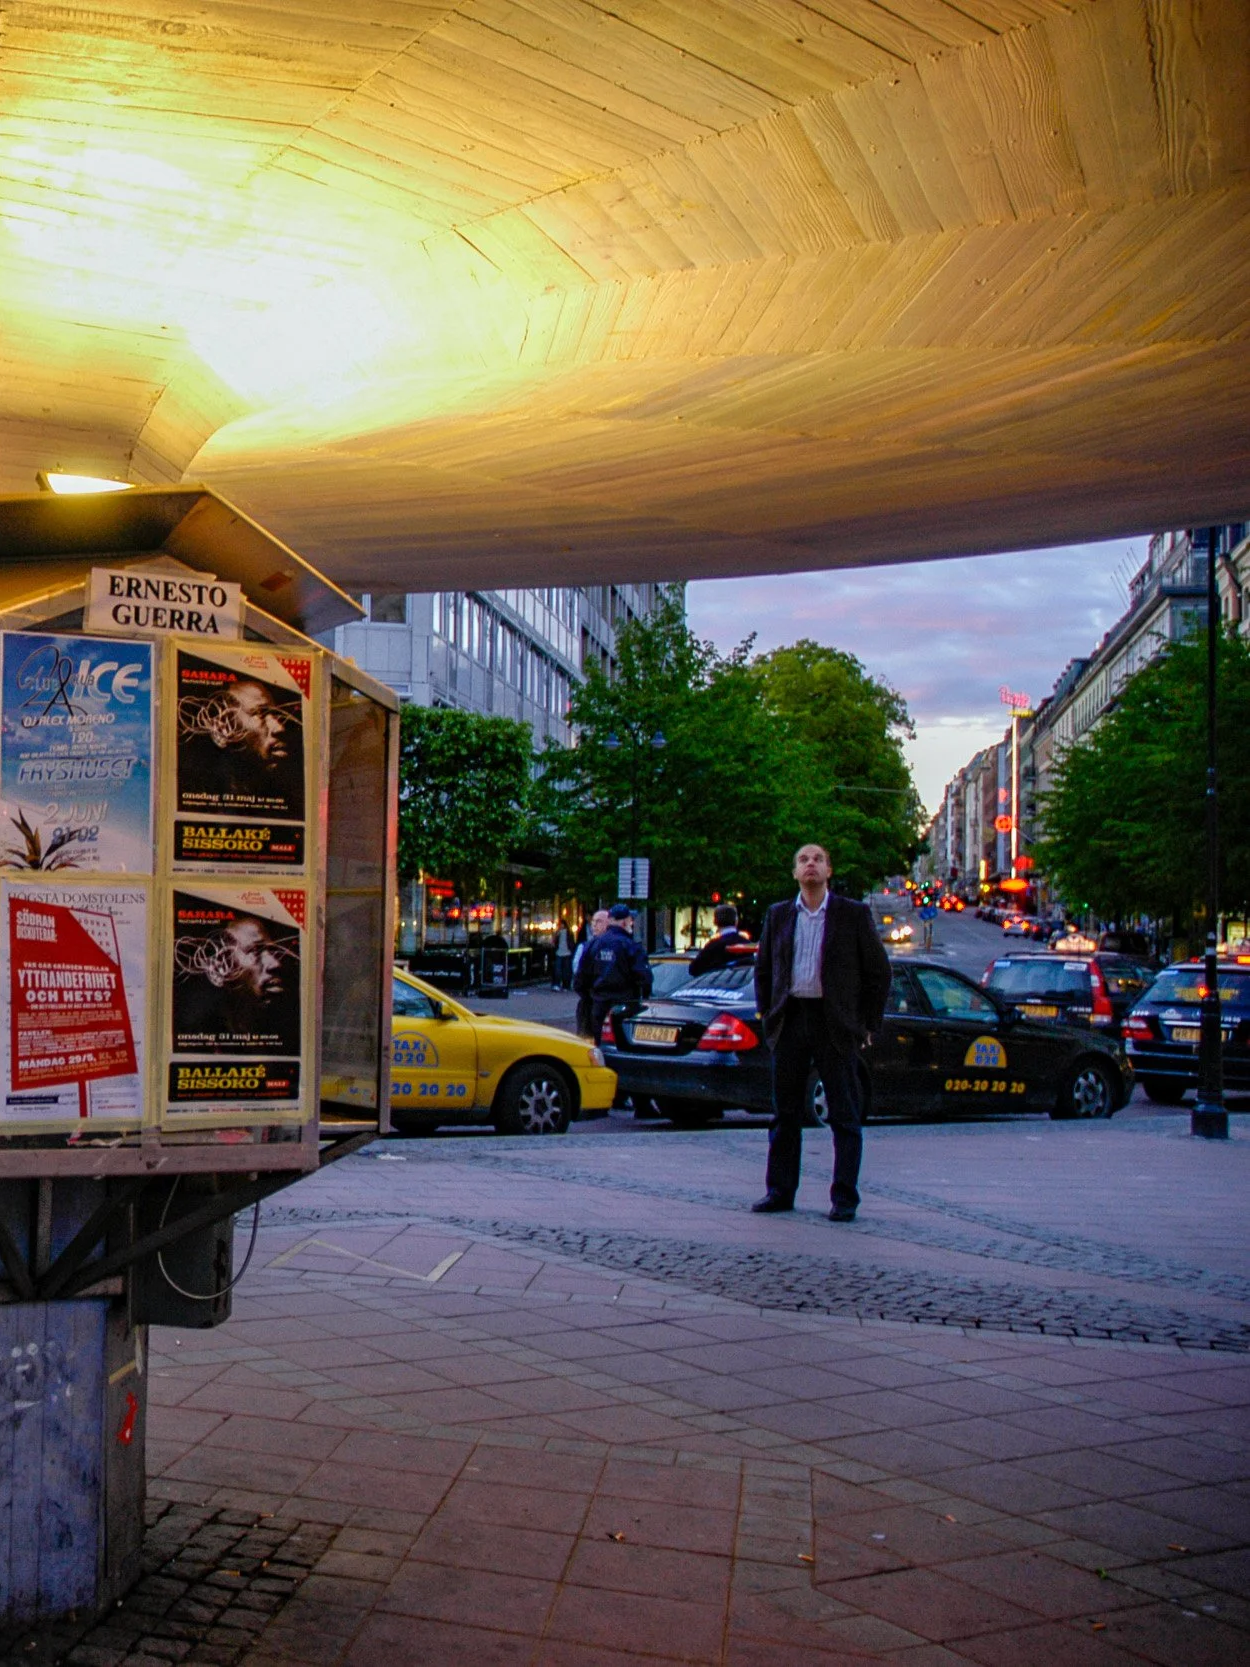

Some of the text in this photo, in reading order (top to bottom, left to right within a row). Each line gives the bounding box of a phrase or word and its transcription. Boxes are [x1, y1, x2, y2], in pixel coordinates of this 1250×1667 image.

[109, 575, 227, 607] ERNESTO
[112, 604, 219, 634] GUERRA
[72, 659, 143, 704] ICE
[181, 669, 238, 682] SAHARA
[67, 712, 116, 726] MORENO
[182, 826, 270, 840] BALLAKÉ
[182, 839, 263, 851] SISSOKO
[62, 892, 146, 904] DOMSTOLENS
[18, 969, 116, 989] YTTRANDEFRIHET
[26, 990, 111, 1003] OCH HETS?
[393, 1052, 426, 1064] 020
[178, 1065, 266, 1078] BALLAKÉ
[178, 1079, 260, 1089] SISSOKO
[419, 1082, 439, 1096] 20
[446, 1083, 466, 1097] 20
